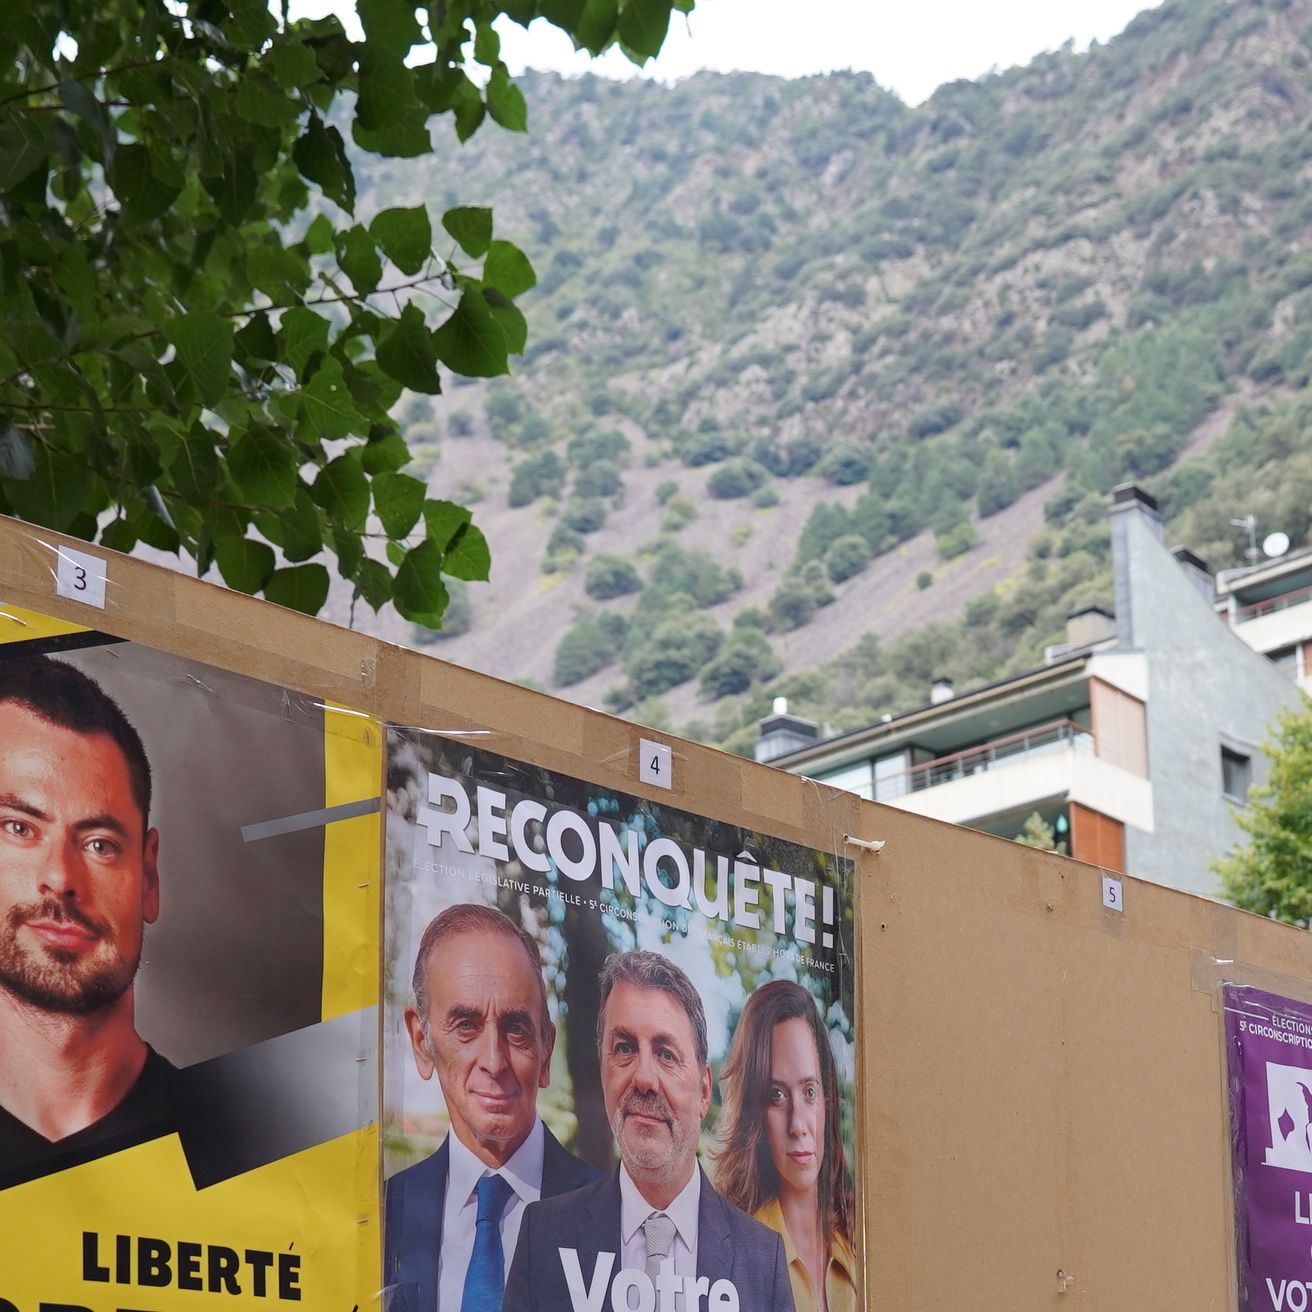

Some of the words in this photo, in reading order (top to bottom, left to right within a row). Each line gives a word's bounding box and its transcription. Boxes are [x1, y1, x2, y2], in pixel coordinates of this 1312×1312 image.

[73, 566, 87, 592] 3
[650, 755, 660, 776] 4
[416, 771, 835, 949] RECONQUÊTE!
[1109, 886, 1116, 903] 5
[533, 885, 581, 906] PARTIELLE
[806, 957, 835, 973] FRANCE
[82, 1231, 302, 1301] LIBERTÉ
